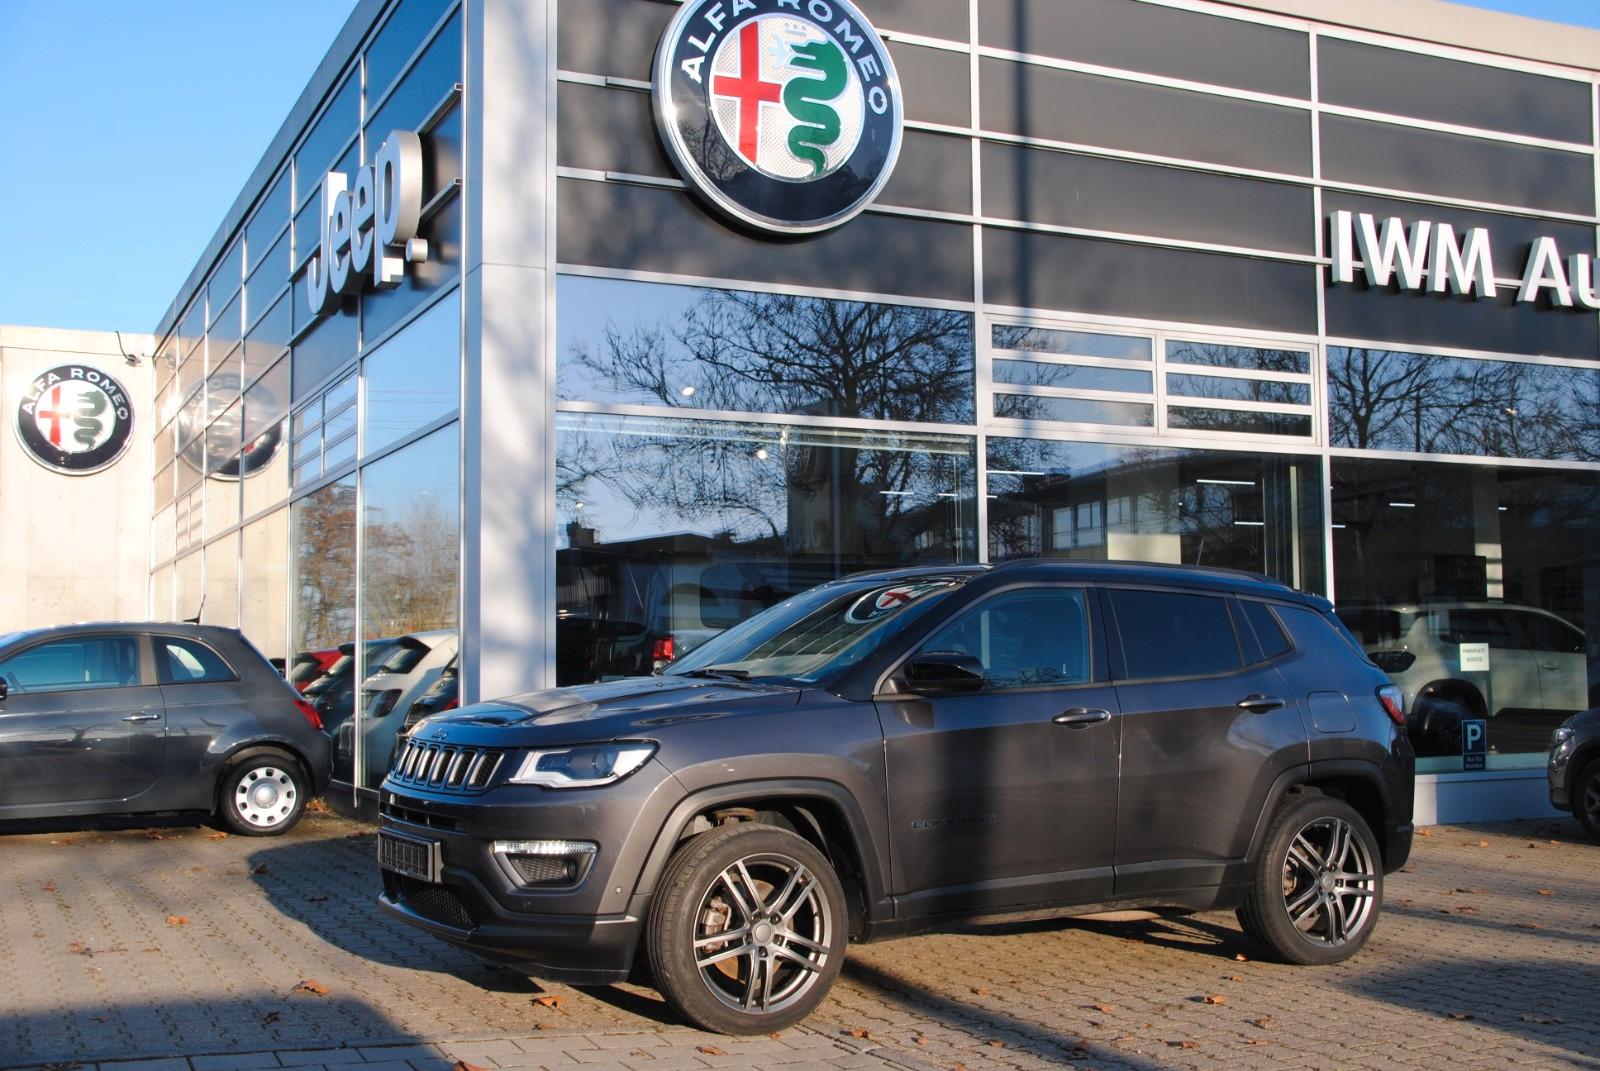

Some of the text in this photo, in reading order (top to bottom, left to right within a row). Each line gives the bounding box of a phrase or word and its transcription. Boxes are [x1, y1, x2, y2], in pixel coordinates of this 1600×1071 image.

[681, 0, 756, 84] ALFA
[308, 130, 424, 315] Jeep
[1330, 210, 1496, 298] IWM
[22, 367, 129, 421] ALFA ROMEO
[1467, 724, 1482, 750] P
